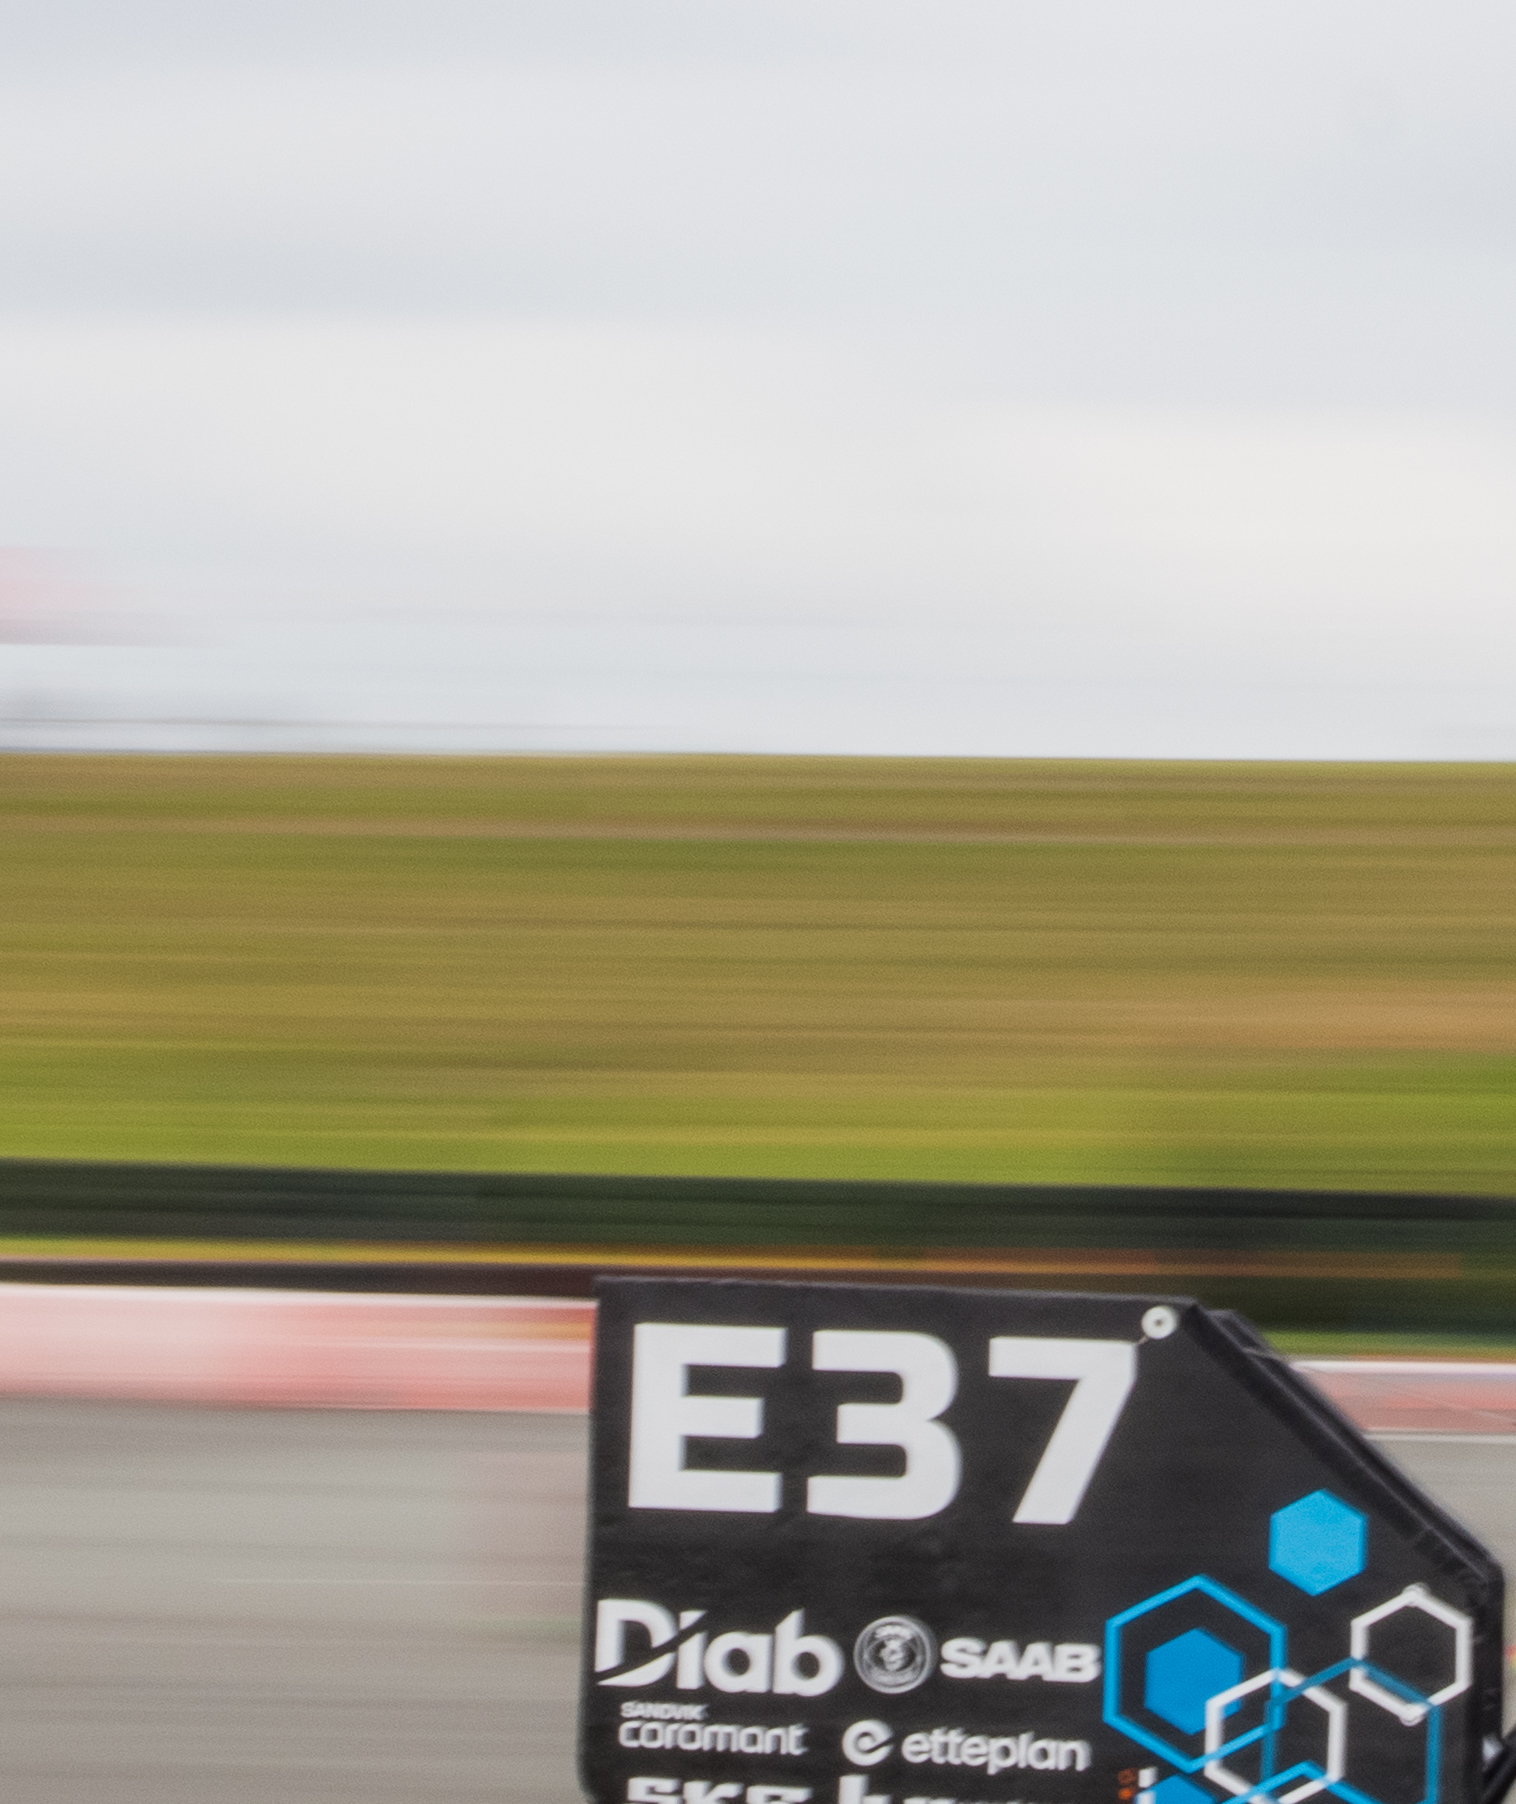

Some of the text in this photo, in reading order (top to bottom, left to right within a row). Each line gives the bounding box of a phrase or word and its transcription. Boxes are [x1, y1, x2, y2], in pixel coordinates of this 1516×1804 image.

[630, 1321, 1138, 1525] E37
[595, 1599, 843, 1696] Diab
[941, 1637, 1101, 1682] SAAB
[620, 1701, 708, 1720] SANDVIK
[902, 1727, 1091, 1775] etteplan
